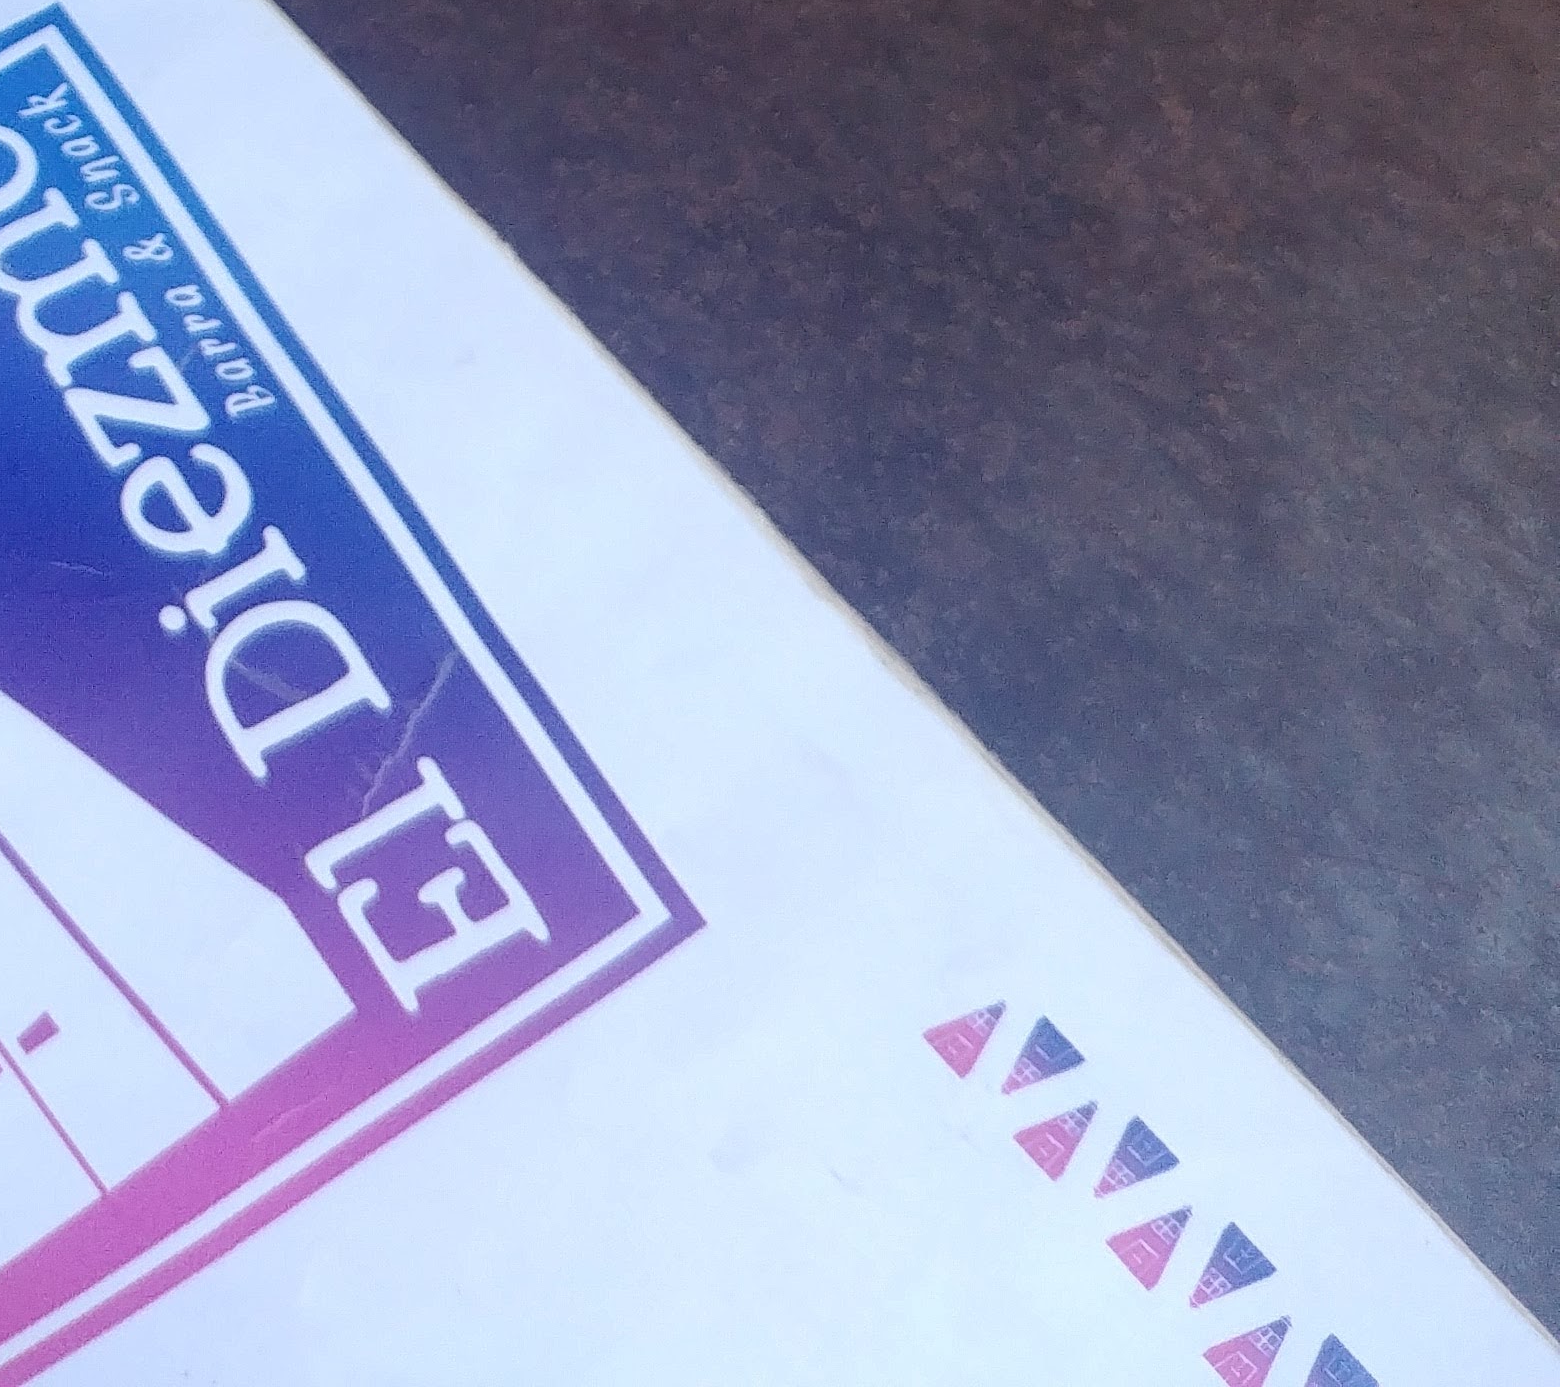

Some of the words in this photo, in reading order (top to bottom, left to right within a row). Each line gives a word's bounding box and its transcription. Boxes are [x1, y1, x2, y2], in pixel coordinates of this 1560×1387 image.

[17, 81, 142, 212] Snack
[121, 231, 175, 263] &
[163, 283, 278, 419] Barra
